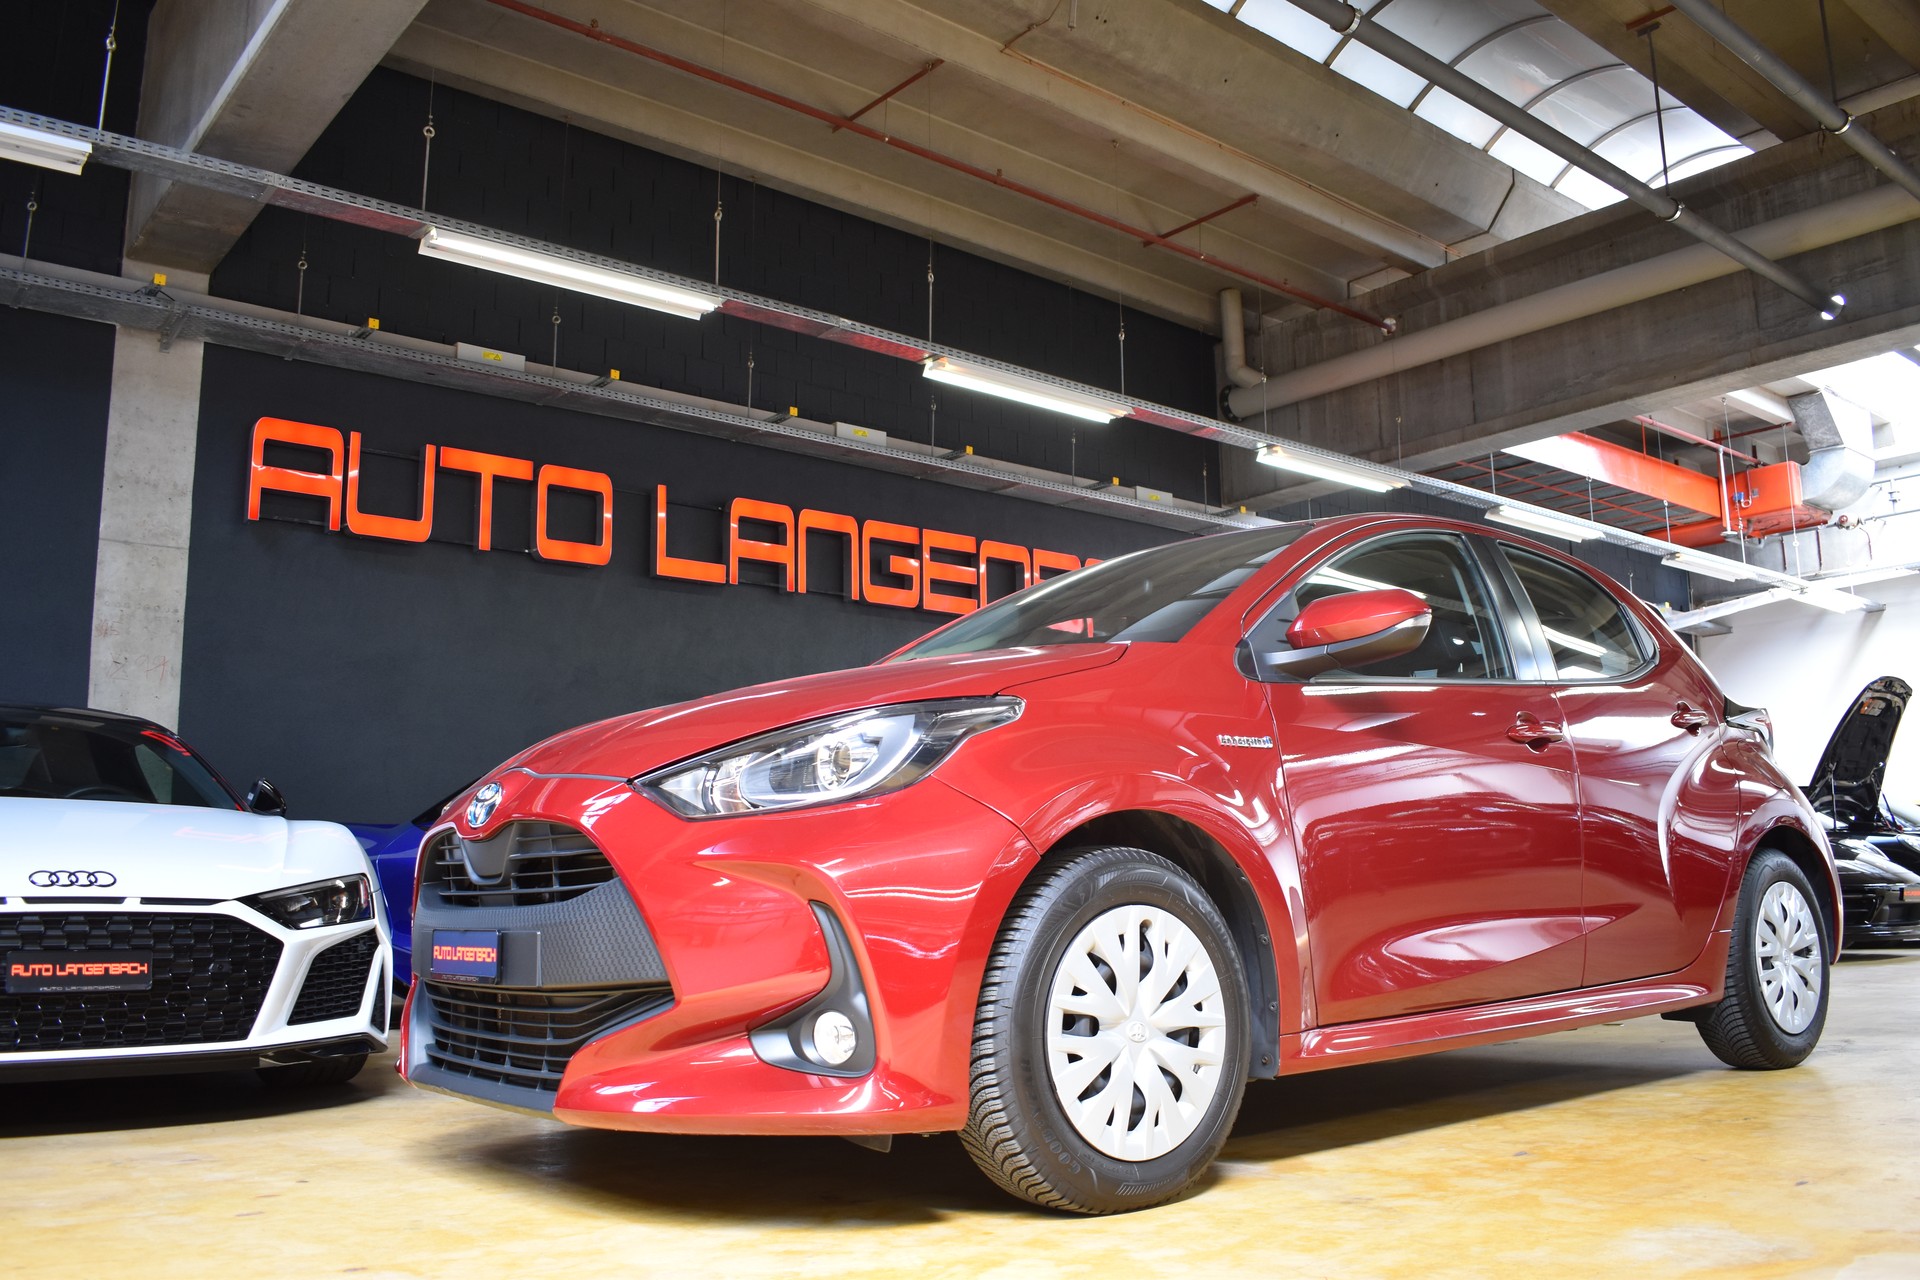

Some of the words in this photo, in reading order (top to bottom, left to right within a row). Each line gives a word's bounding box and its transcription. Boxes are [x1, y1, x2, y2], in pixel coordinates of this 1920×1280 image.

[247, 417, 613, 566] AUTO
[655, 484, 1105, 615] LANGEN
[433, 945, 452, 960] AUTO
[452, 946, 497, 962] LANGENBACH
[11, 963, 53, 977] AUTO
[56, 962, 148, 976] LANGENBACH
